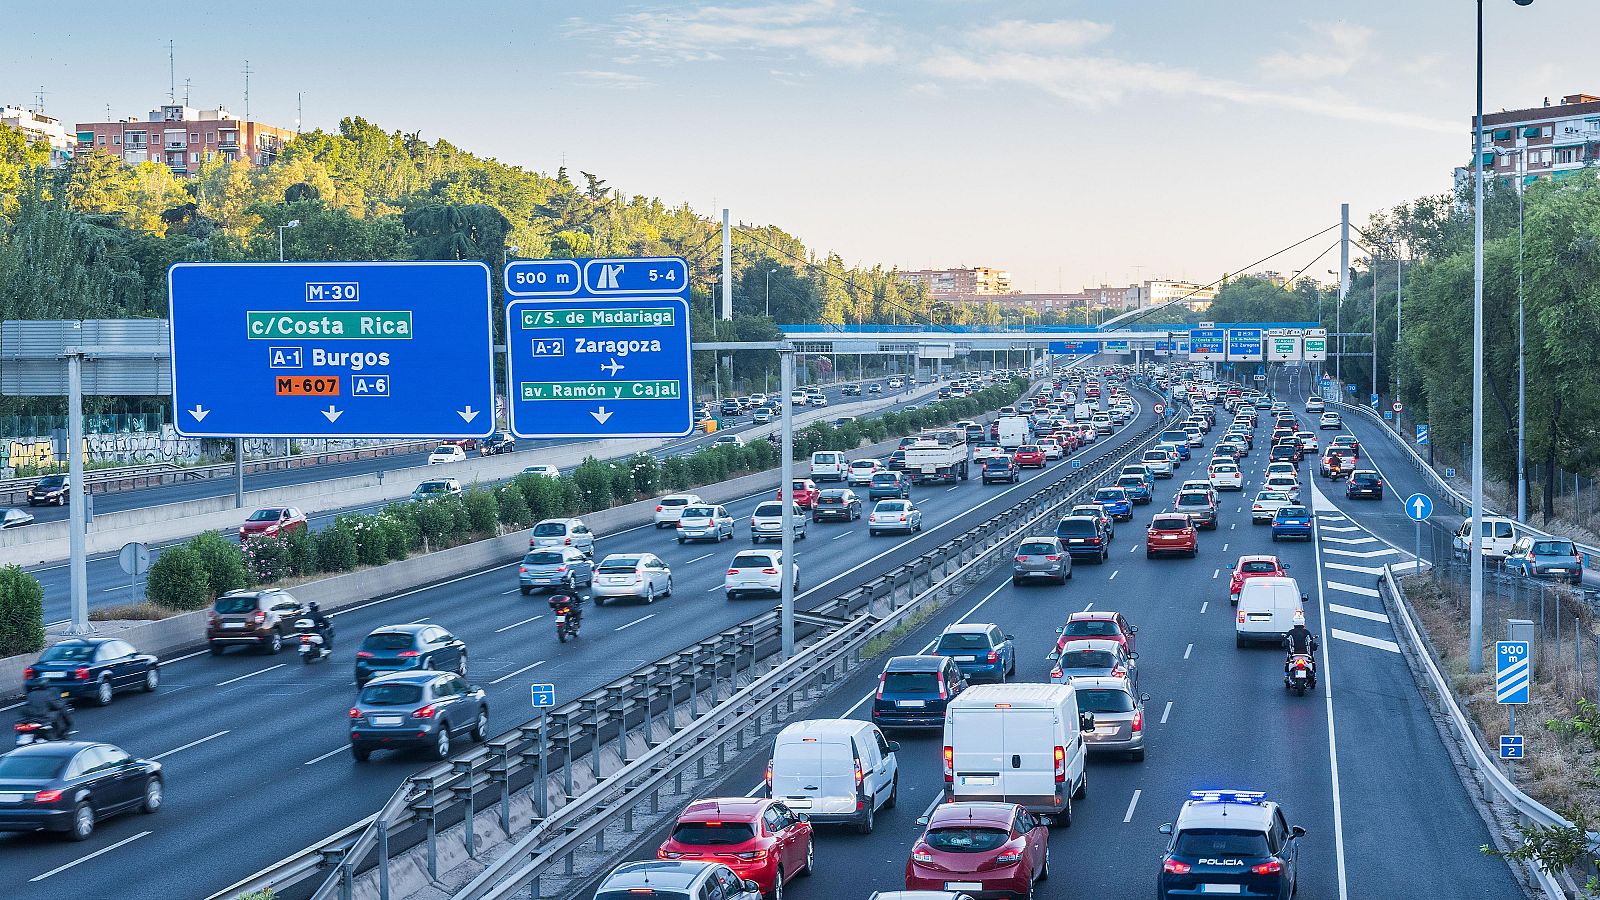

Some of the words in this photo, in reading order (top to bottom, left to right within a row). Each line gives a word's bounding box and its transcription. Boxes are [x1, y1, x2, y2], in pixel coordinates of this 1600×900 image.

[516, 272, 547, 284] 500
[556, 273, 570, 284] m
[649, 269, 676, 282] 5-4
[309, 285, 356, 300] M-30
[524, 311, 560, 325] c/S.
[566, 311, 585, 324] de
[593, 310, 672, 326] Madariaga
[251, 316, 344, 336] c/Costa
[360, 316, 409, 335] Rica
[536, 341, 562, 354] A-2
[575, 338, 662, 357] Zaragoza
[273, 350, 300, 366] A-1
[312, 349, 390, 371] Burgos
[278, 378, 337, 393] M-607
[355, 378, 386, 393] A-6
[524, 386, 547, 397] av.
[552, 384, 606, 397] Ramón
[613, 385, 623, 398] y
[632, 382, 677, 397] Cajal
[1500, 645, 1524, 655] 300
[1508, 655, 1518, 663] m
[540, 694, 547, 704] 2
[1507, 747, 1516, 756] 2
